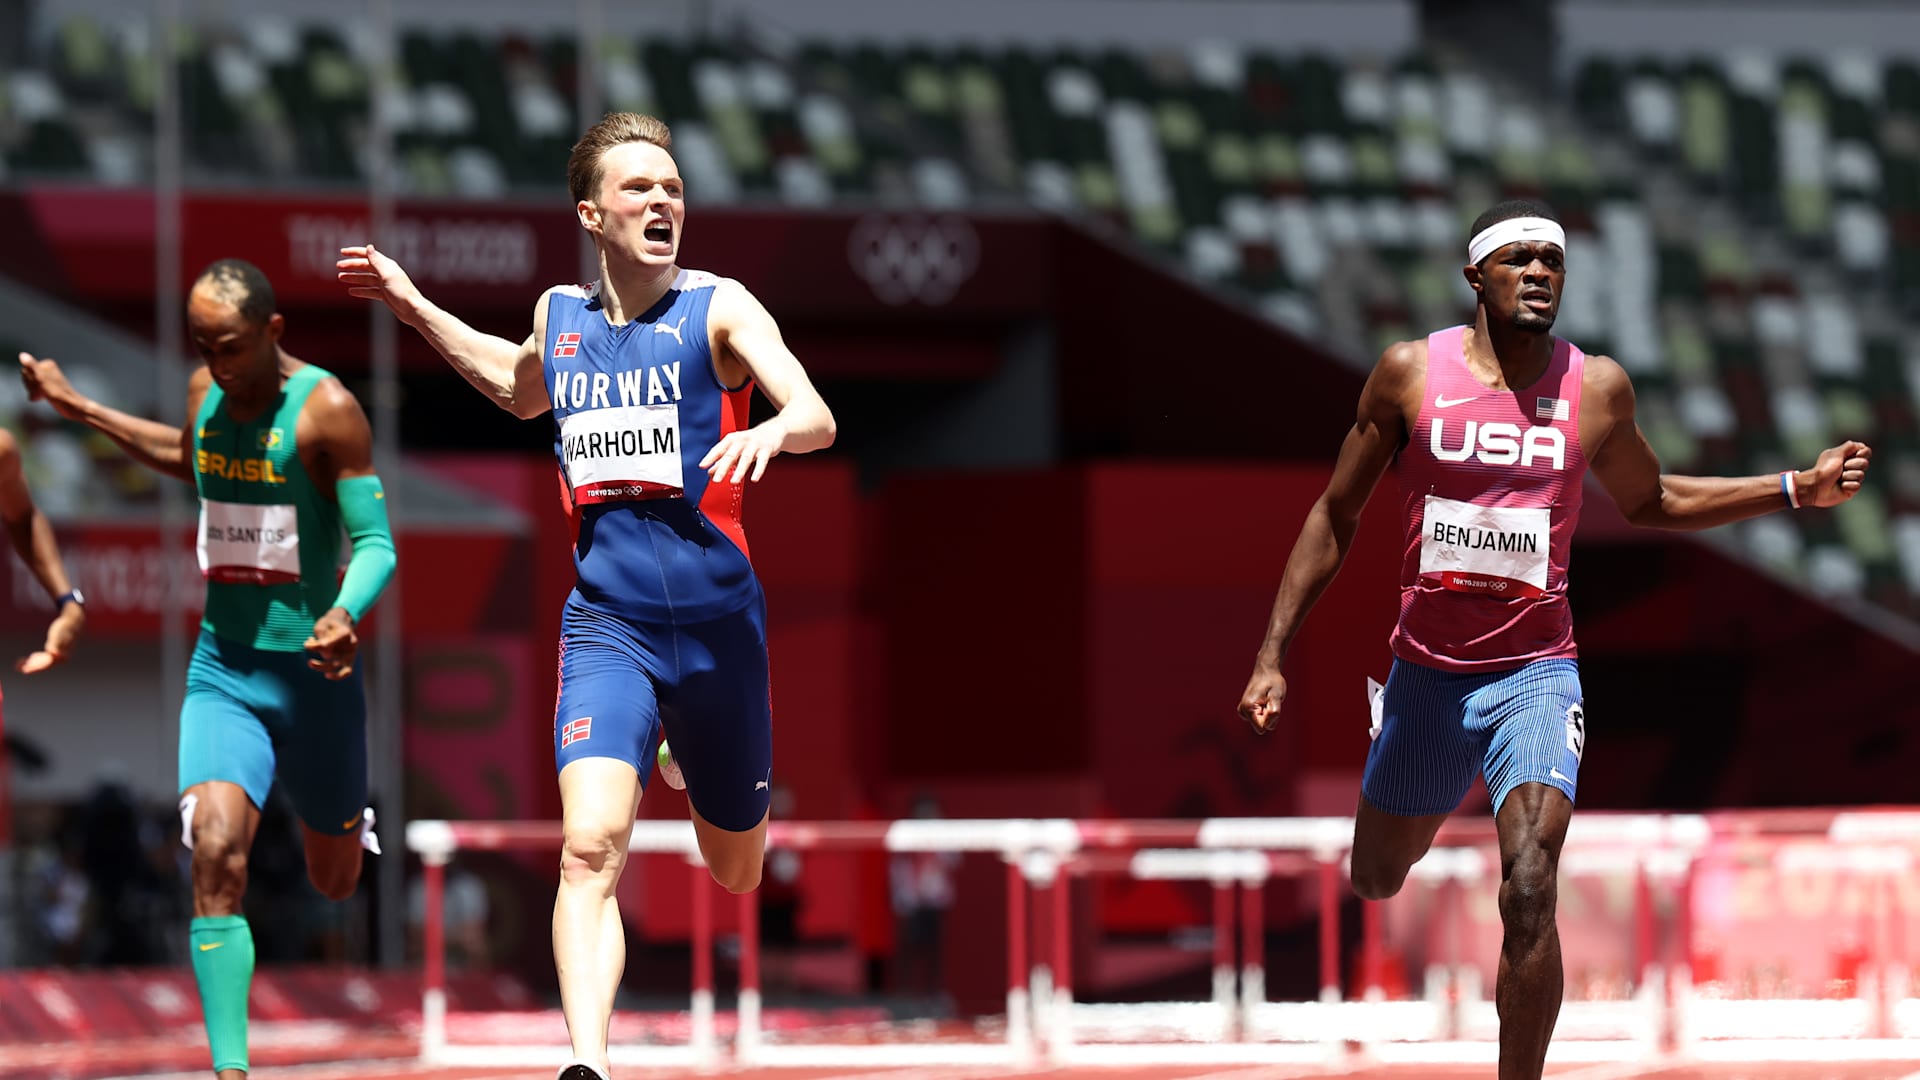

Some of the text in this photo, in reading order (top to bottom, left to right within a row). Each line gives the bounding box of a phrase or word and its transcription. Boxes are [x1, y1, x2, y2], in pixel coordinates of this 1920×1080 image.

[553, 361, 682, 409] NORWAY
[564, 427, 675, 462] WARHOLM
[1430, 417, 1566, 470] USA
[197, 450, 286, 484] BRASIL
[227, 525, 285, 544] SANTOS
[1433, 522, 1537, 553] BENJAMIN
